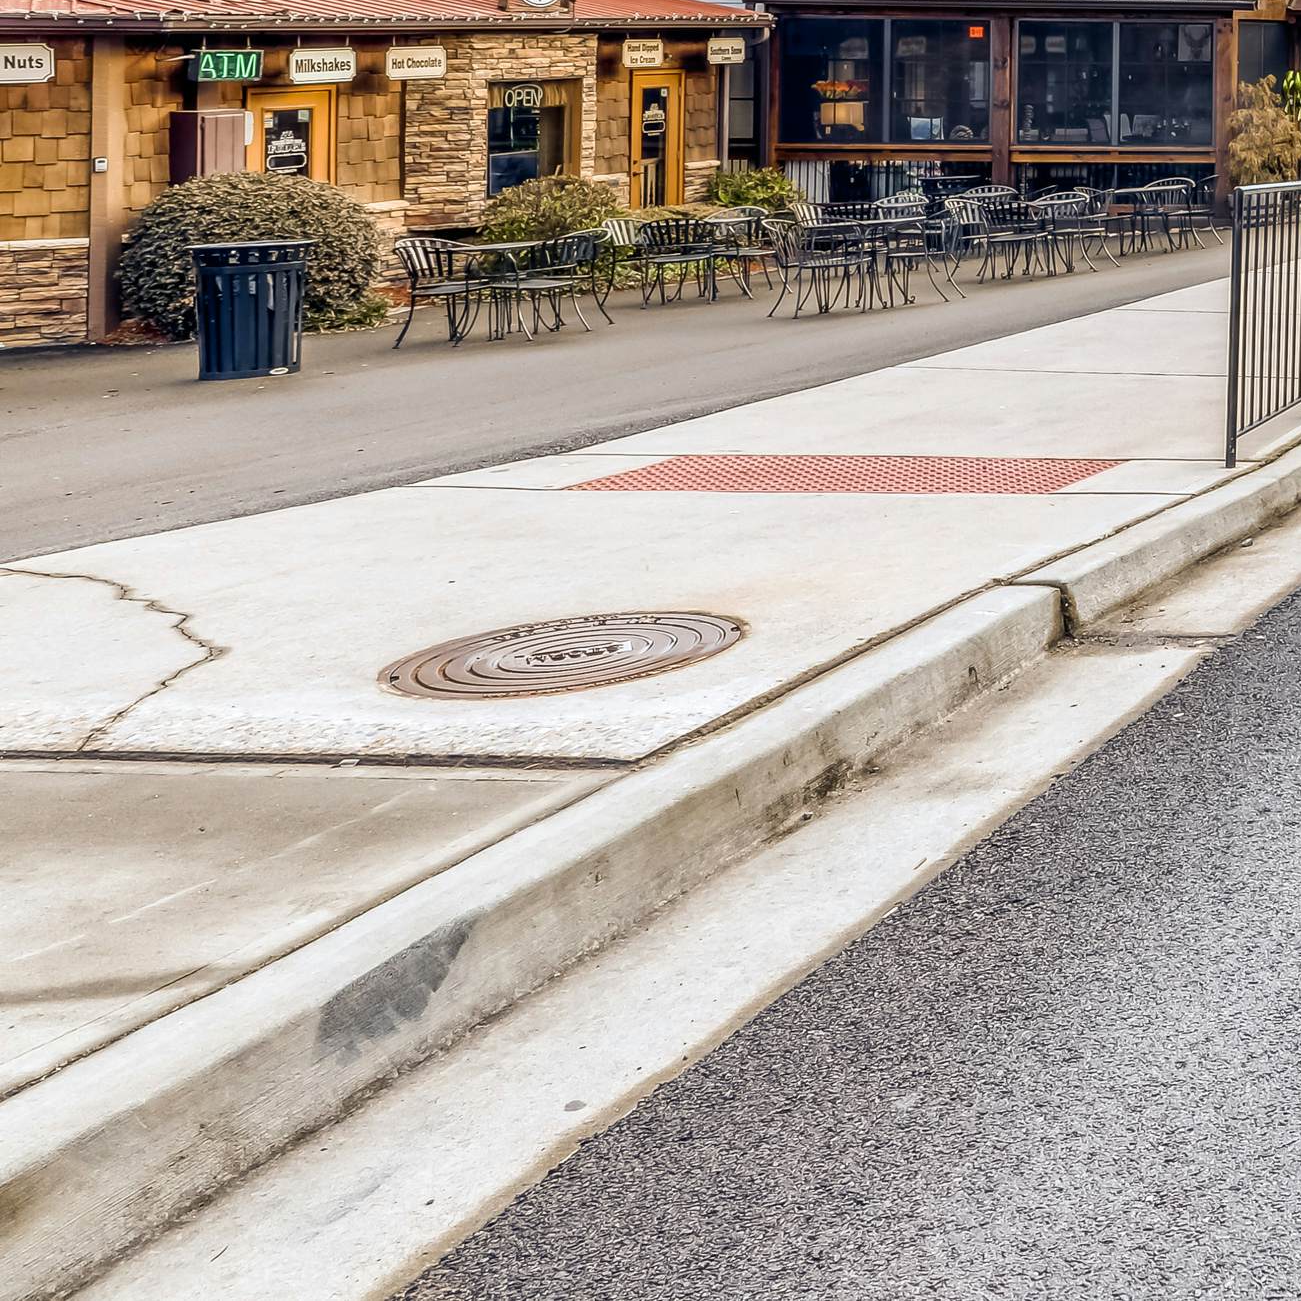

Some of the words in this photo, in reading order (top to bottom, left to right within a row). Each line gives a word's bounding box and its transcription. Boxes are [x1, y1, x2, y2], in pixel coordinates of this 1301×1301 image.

[627, 44, 641, 52] Hand
[642, 44, 659, 52] Dipped
[4, 55, 44, 69] Nuts
[200, 53, 257, 78] ATM
[295, 58, 352, 73] Milkshakes
[392, 58, 405, 69] Hot
[406, 57, 442, 69] Chocolate
[639, 56, 655, 64] Cream
[505, 89, 541, 108] OPEN
